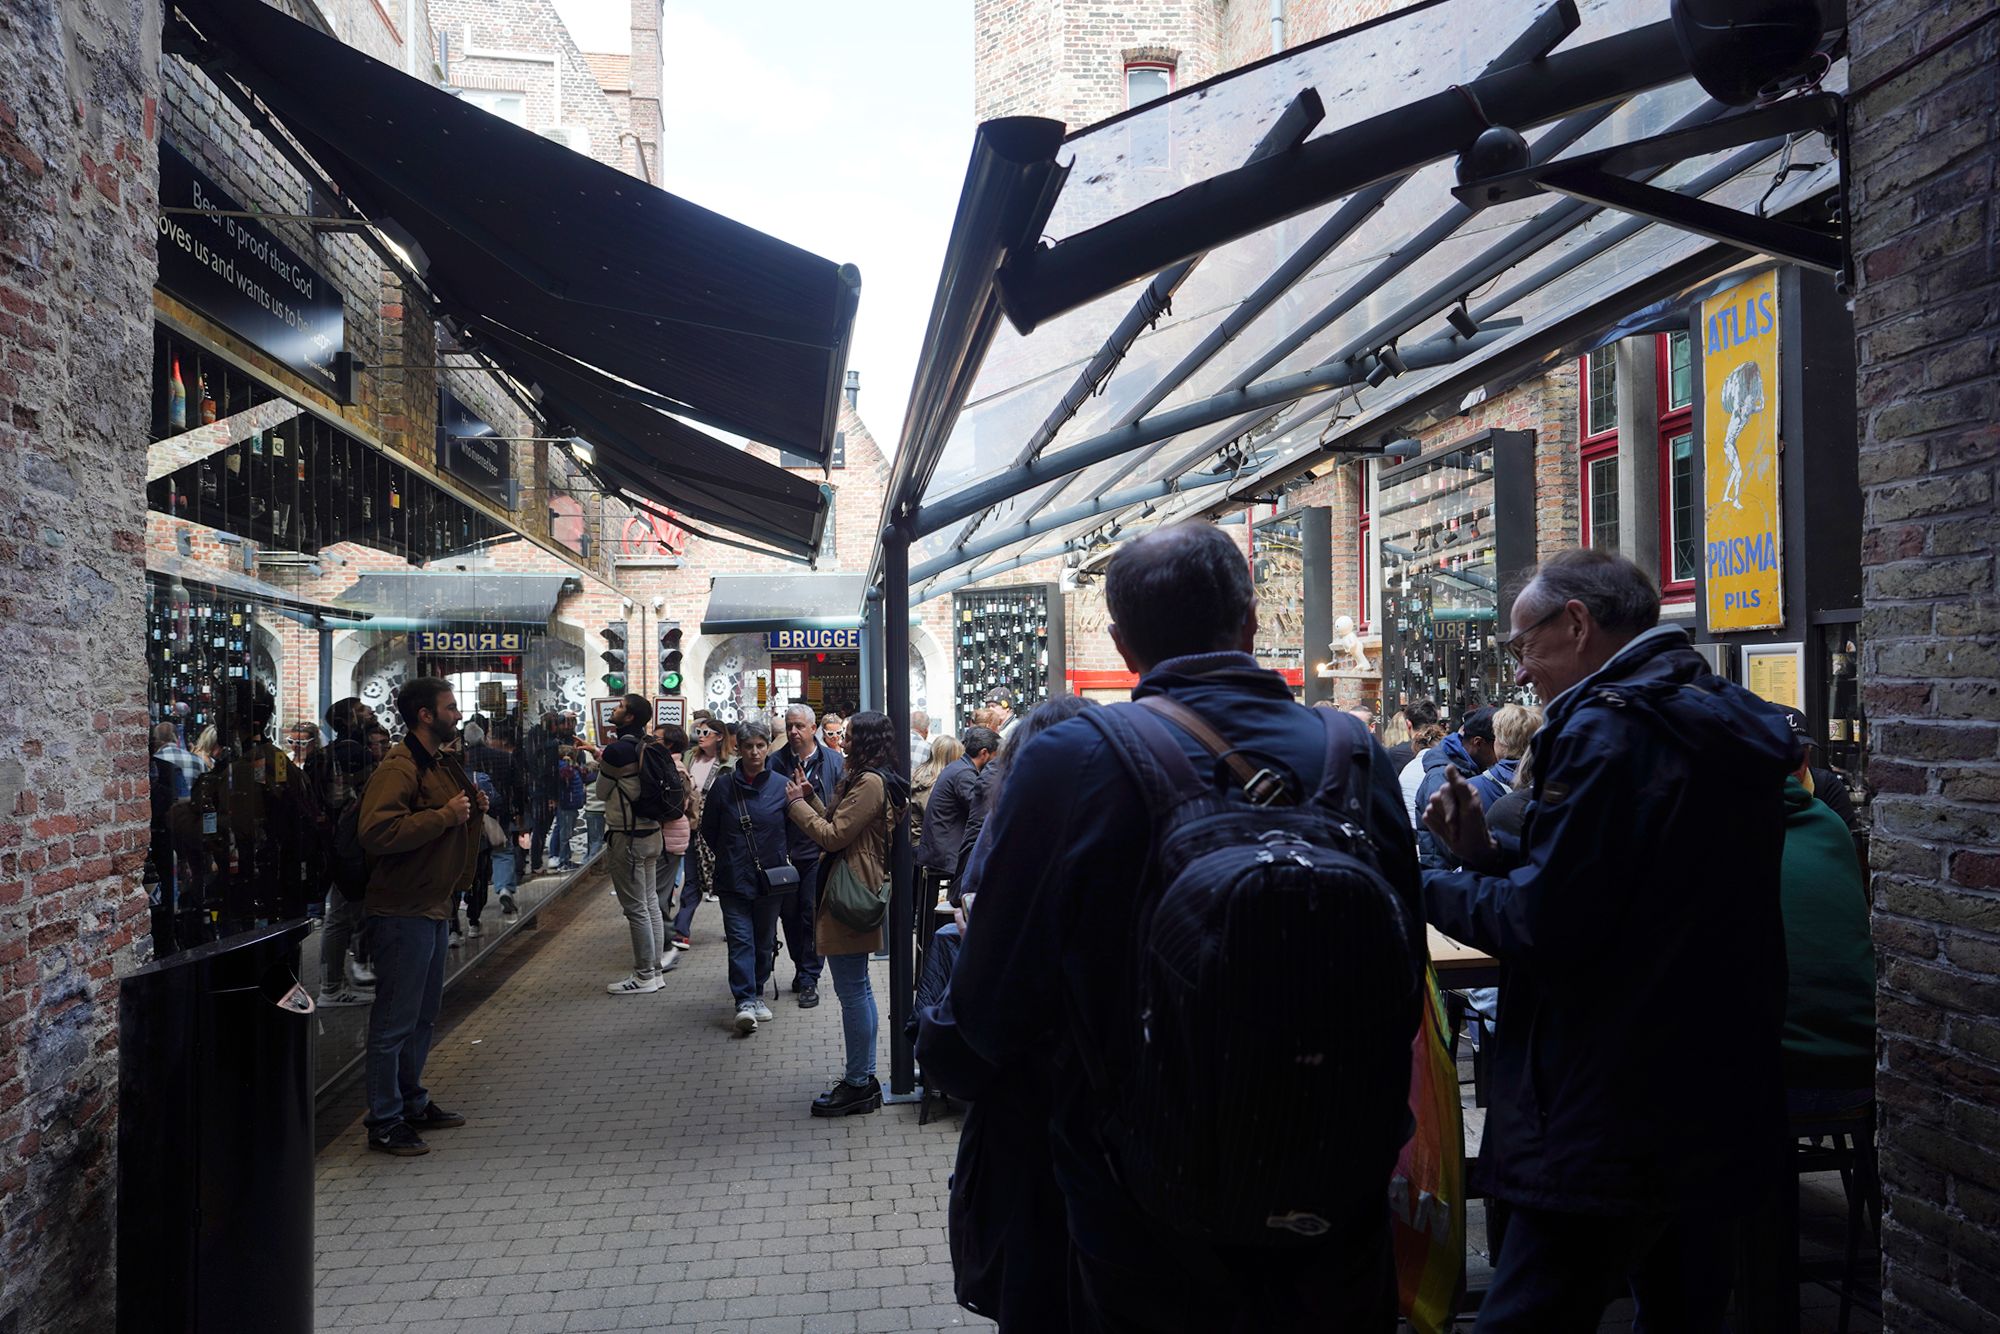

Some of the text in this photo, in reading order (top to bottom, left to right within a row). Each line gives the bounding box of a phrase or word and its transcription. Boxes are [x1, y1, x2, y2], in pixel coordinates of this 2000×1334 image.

[193, 180, 312, 300] Beer is proof that God
[158, 215, 192, 253] oves
[194, 239, 209, 265] us
[211, 253, 234, 285] and
[236, 270, 270, 310] wants
[272, 297, 283, 319] us
[285, 306, 296, 328] to
[297, 309, 309, 332] be
[1708, 292, 1774, 356] ATLAS
[1708, 532, 1777, 579] PRISMA
[1725, 589, 1761, 610] PILS
[779, 630, 858, 647] BRUGGE
